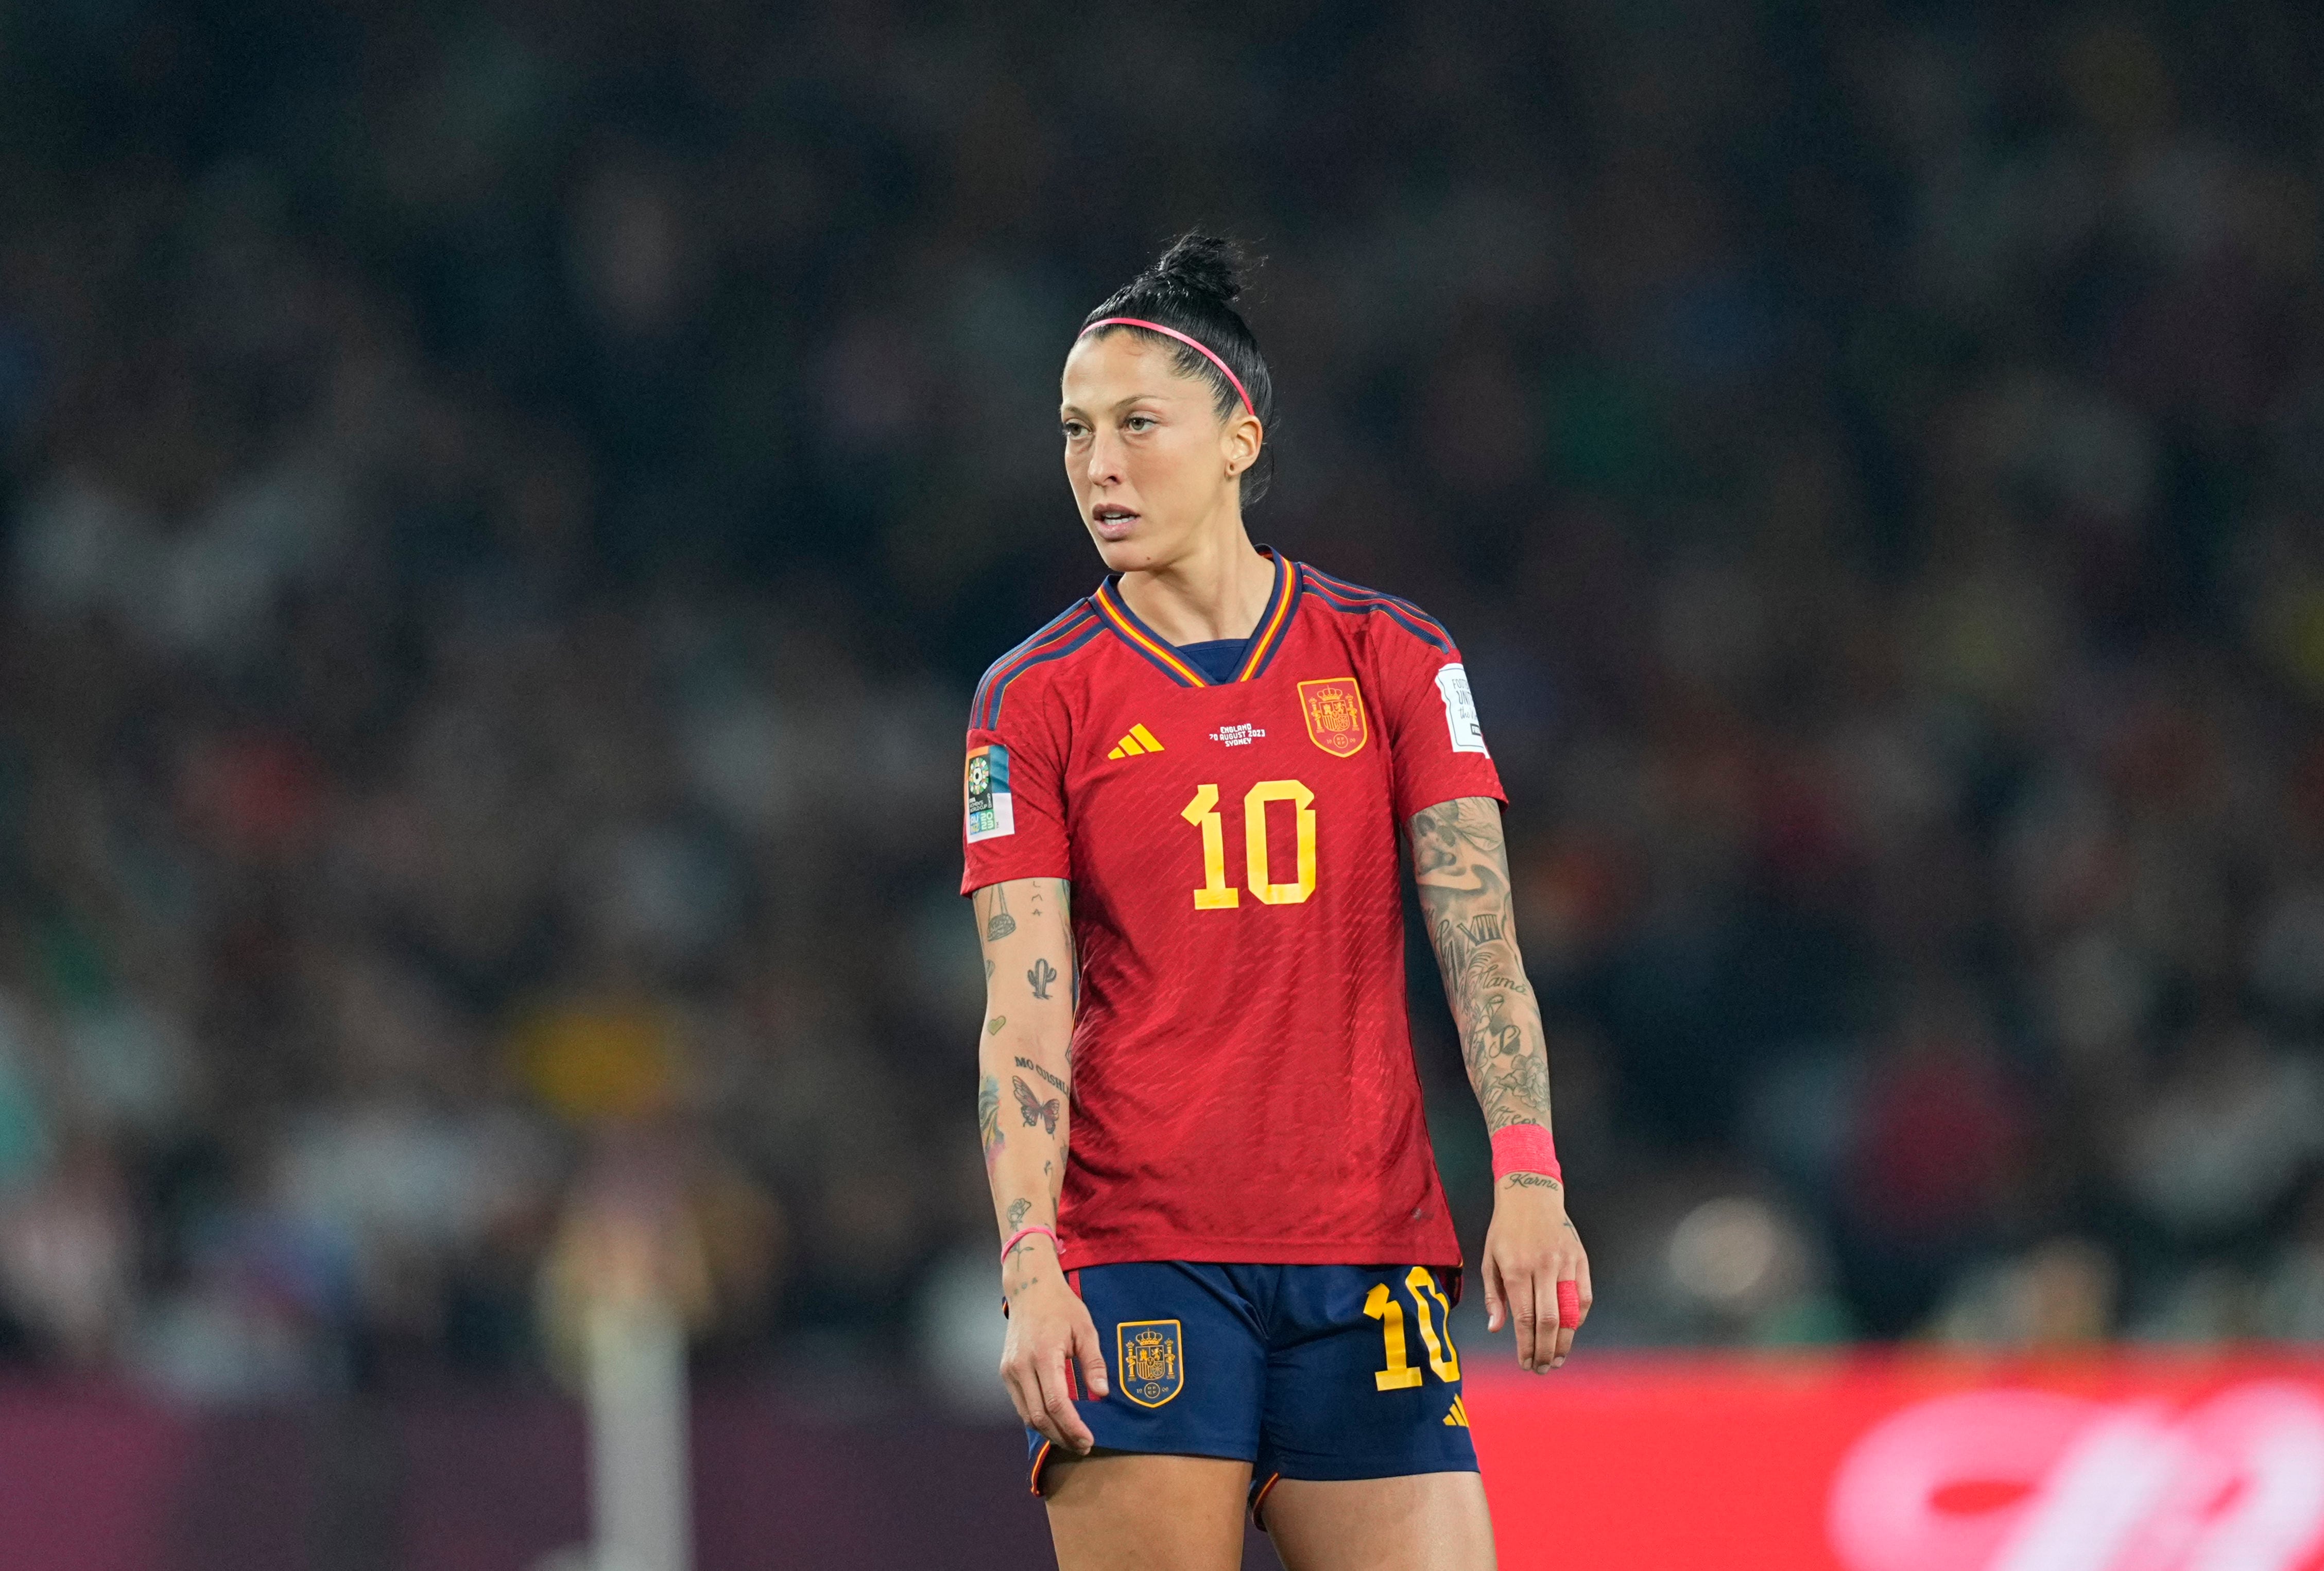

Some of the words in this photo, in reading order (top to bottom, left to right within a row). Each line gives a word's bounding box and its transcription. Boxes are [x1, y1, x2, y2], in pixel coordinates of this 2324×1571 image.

[1219, 731, 1246, 741] AUGUST
[1247, 729, 1265, 737] 2023
[1220, 723, 1252, 734] ENGLAND
[1225, 737, 1252, 747] SYDNEY
[1180, 780, 1316, 910] 10
[1014, 1056, 1034, 1070] MO
[1504, 1173, 1558, 1191] Karma
[1363, 1266, 1460, 1391] 10
